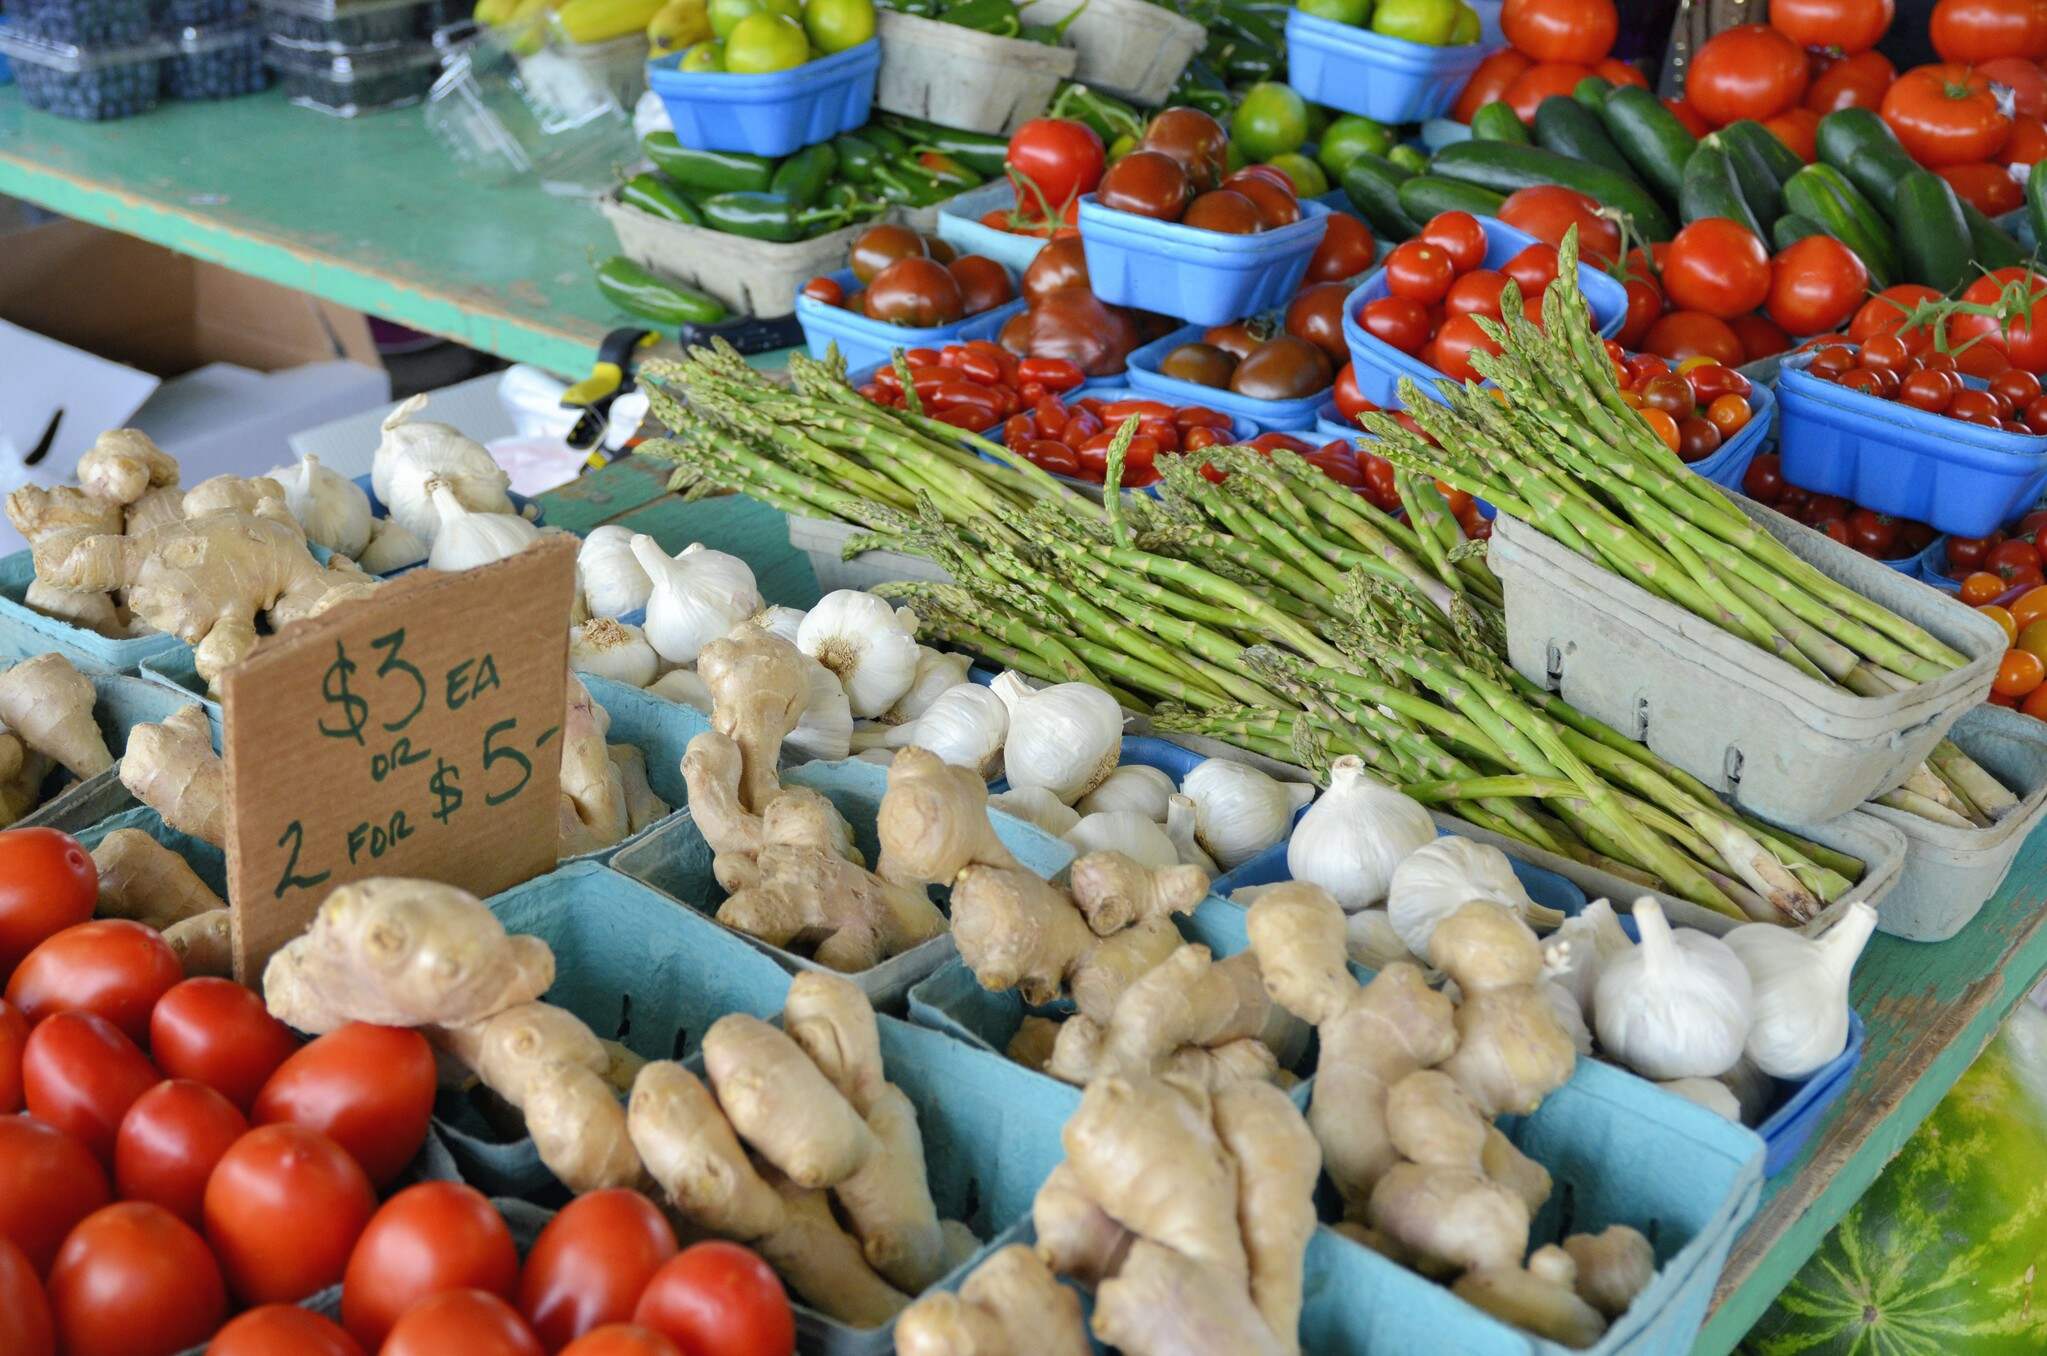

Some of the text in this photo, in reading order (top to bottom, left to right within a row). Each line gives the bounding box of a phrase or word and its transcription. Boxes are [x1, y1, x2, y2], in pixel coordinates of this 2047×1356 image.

[318, 628, 502, 746] $3 EA
[371, 737, 432, 782] OR
[274, 820, 331, 899] 2
[347, 810, 415, 864] FOR
